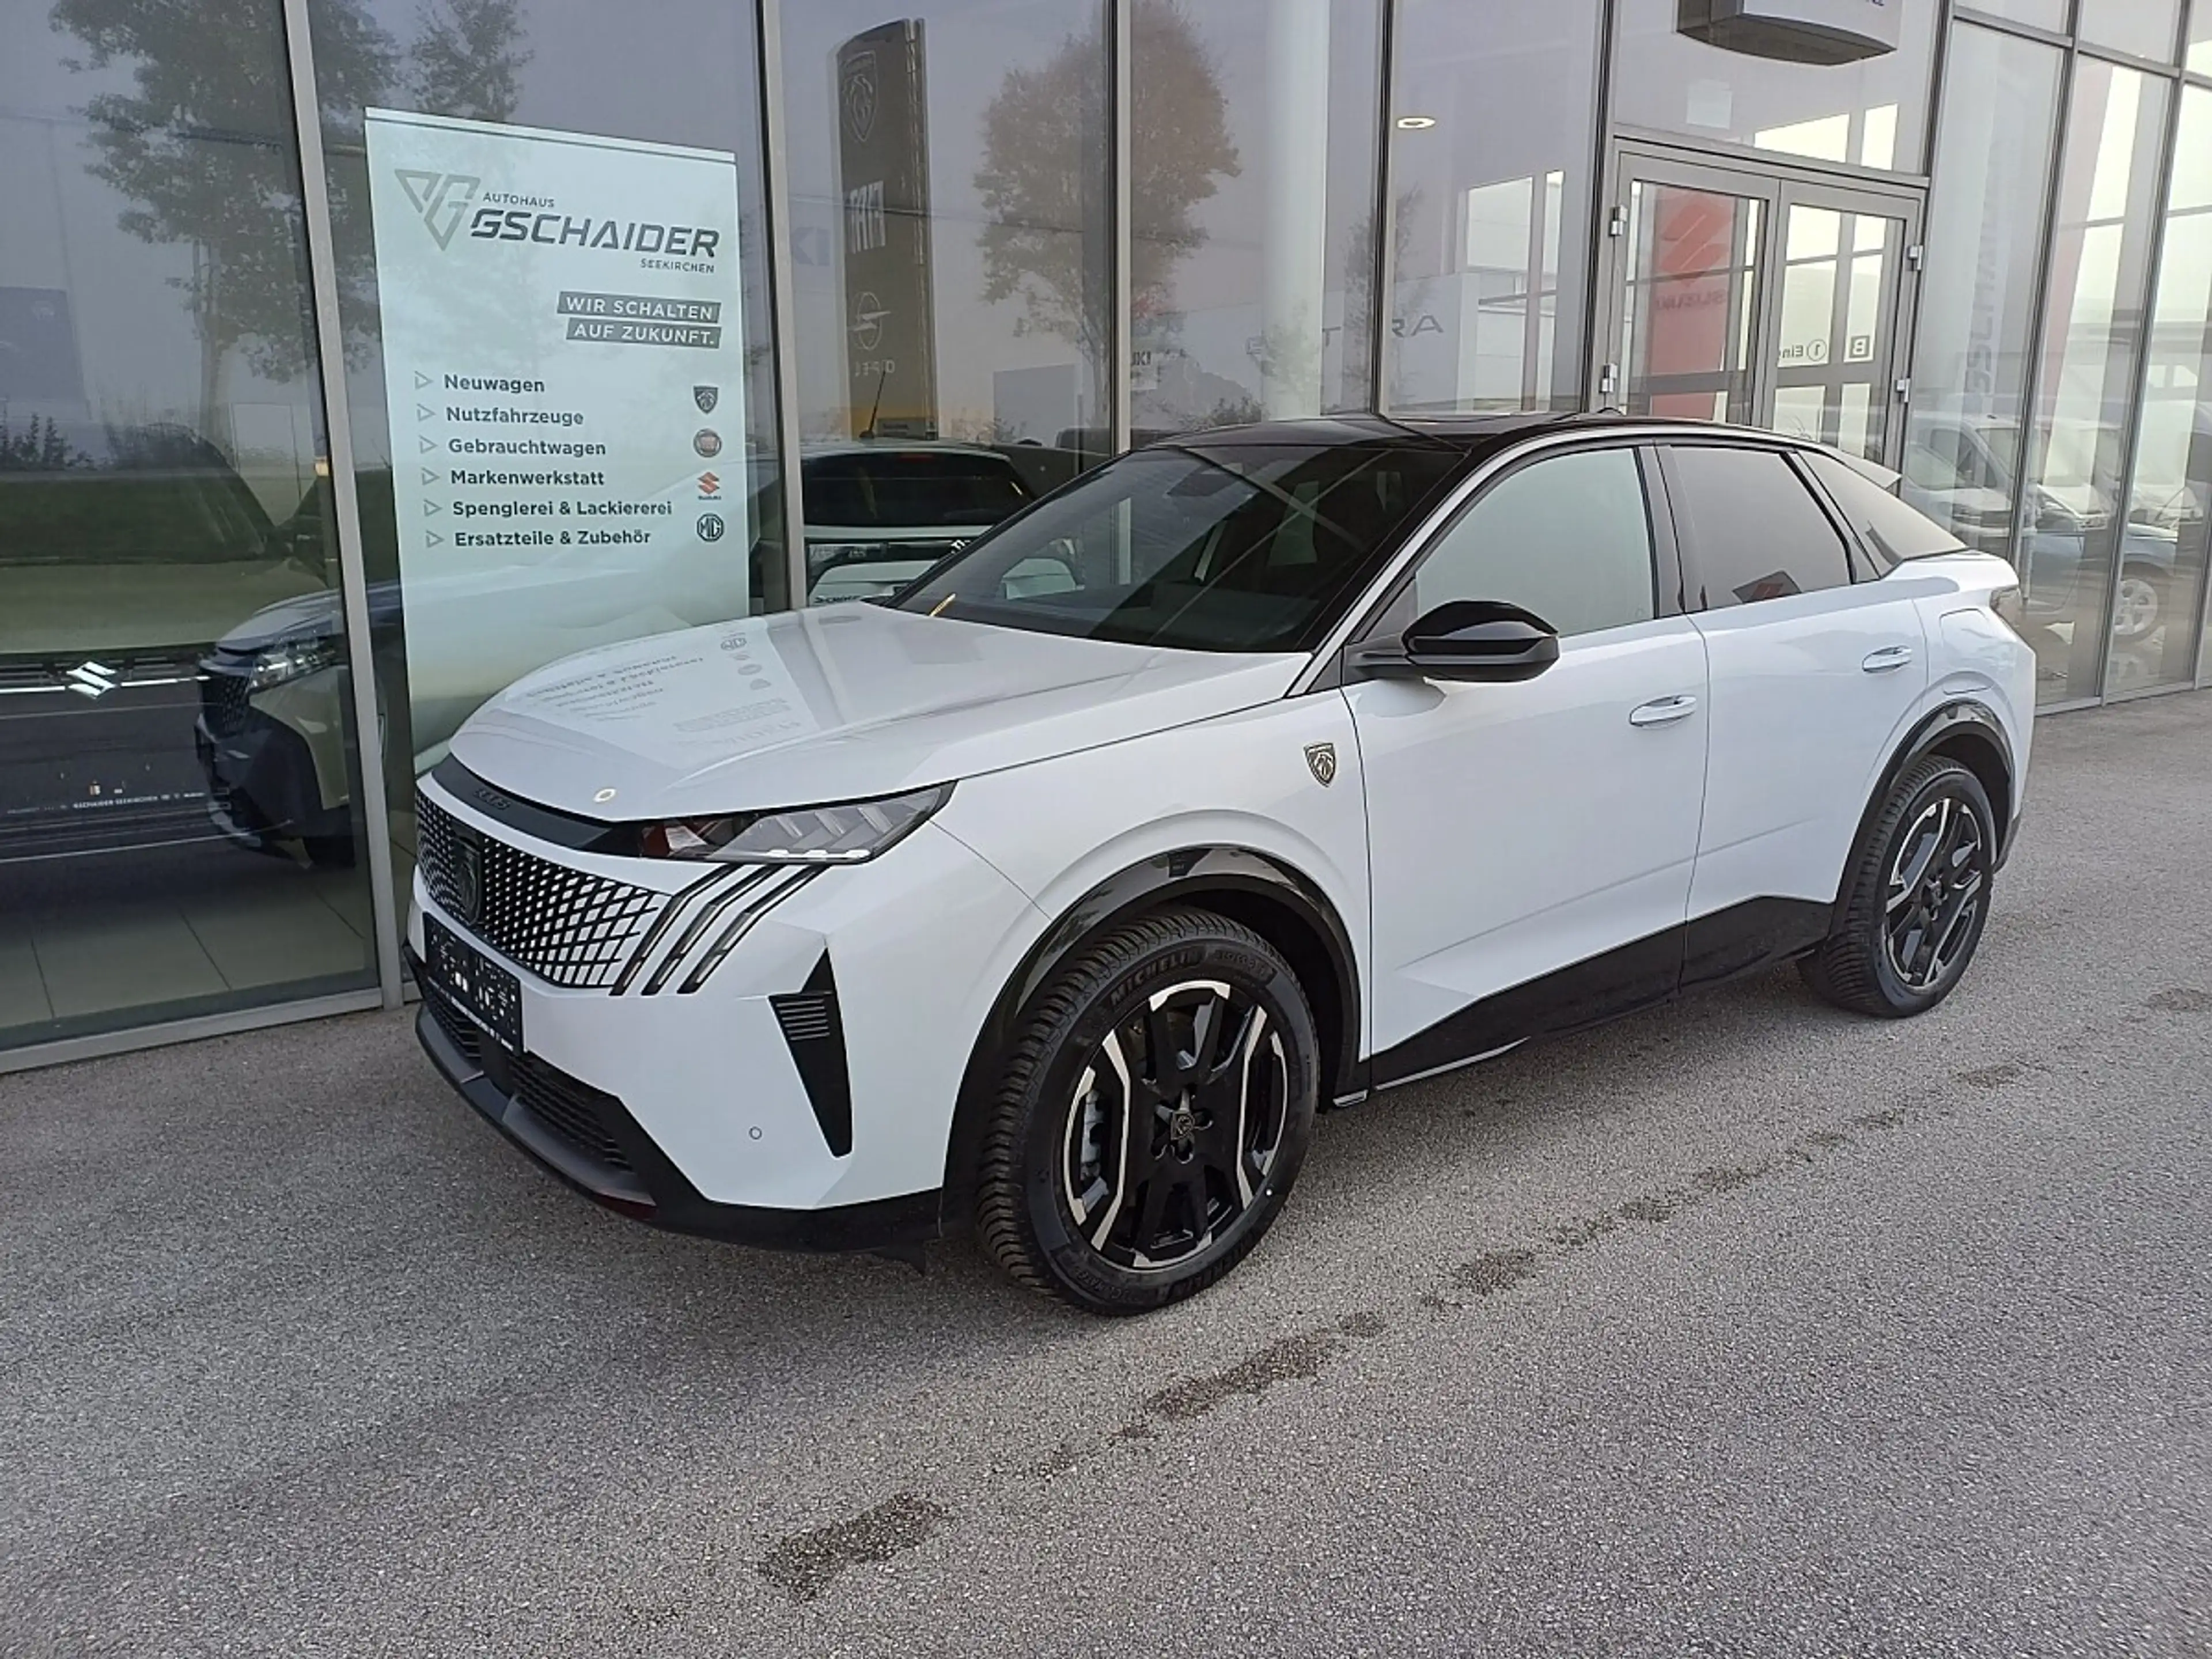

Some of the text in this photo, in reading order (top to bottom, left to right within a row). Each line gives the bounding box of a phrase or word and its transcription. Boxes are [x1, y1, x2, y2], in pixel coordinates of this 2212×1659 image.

[482, 192, 555, 208] AUTOHAUS
[470, 209, 720, 258] GSCHAIDER
[640, 258, 715, 274] SEEKIRCHEN
[565, 297, 713, 320] WIR SCHALTEN
[573, 323, 715, 345] AUF ZUKUNFT.
[444, 374, 544, 393] Neuwagen
[446, 406, 584, 426] Nutzfahrzeuge
[449, 438, 606, 457] Gebrauchtwagen
[451, 469, 604, 485] Markenwerkstatt
[453, 501, 672, 517] Spenglerei & Lackiererei
[455, 529, 651, 546] Ersatzteile & Zubehör
[699, 516, 722, 540] MG
